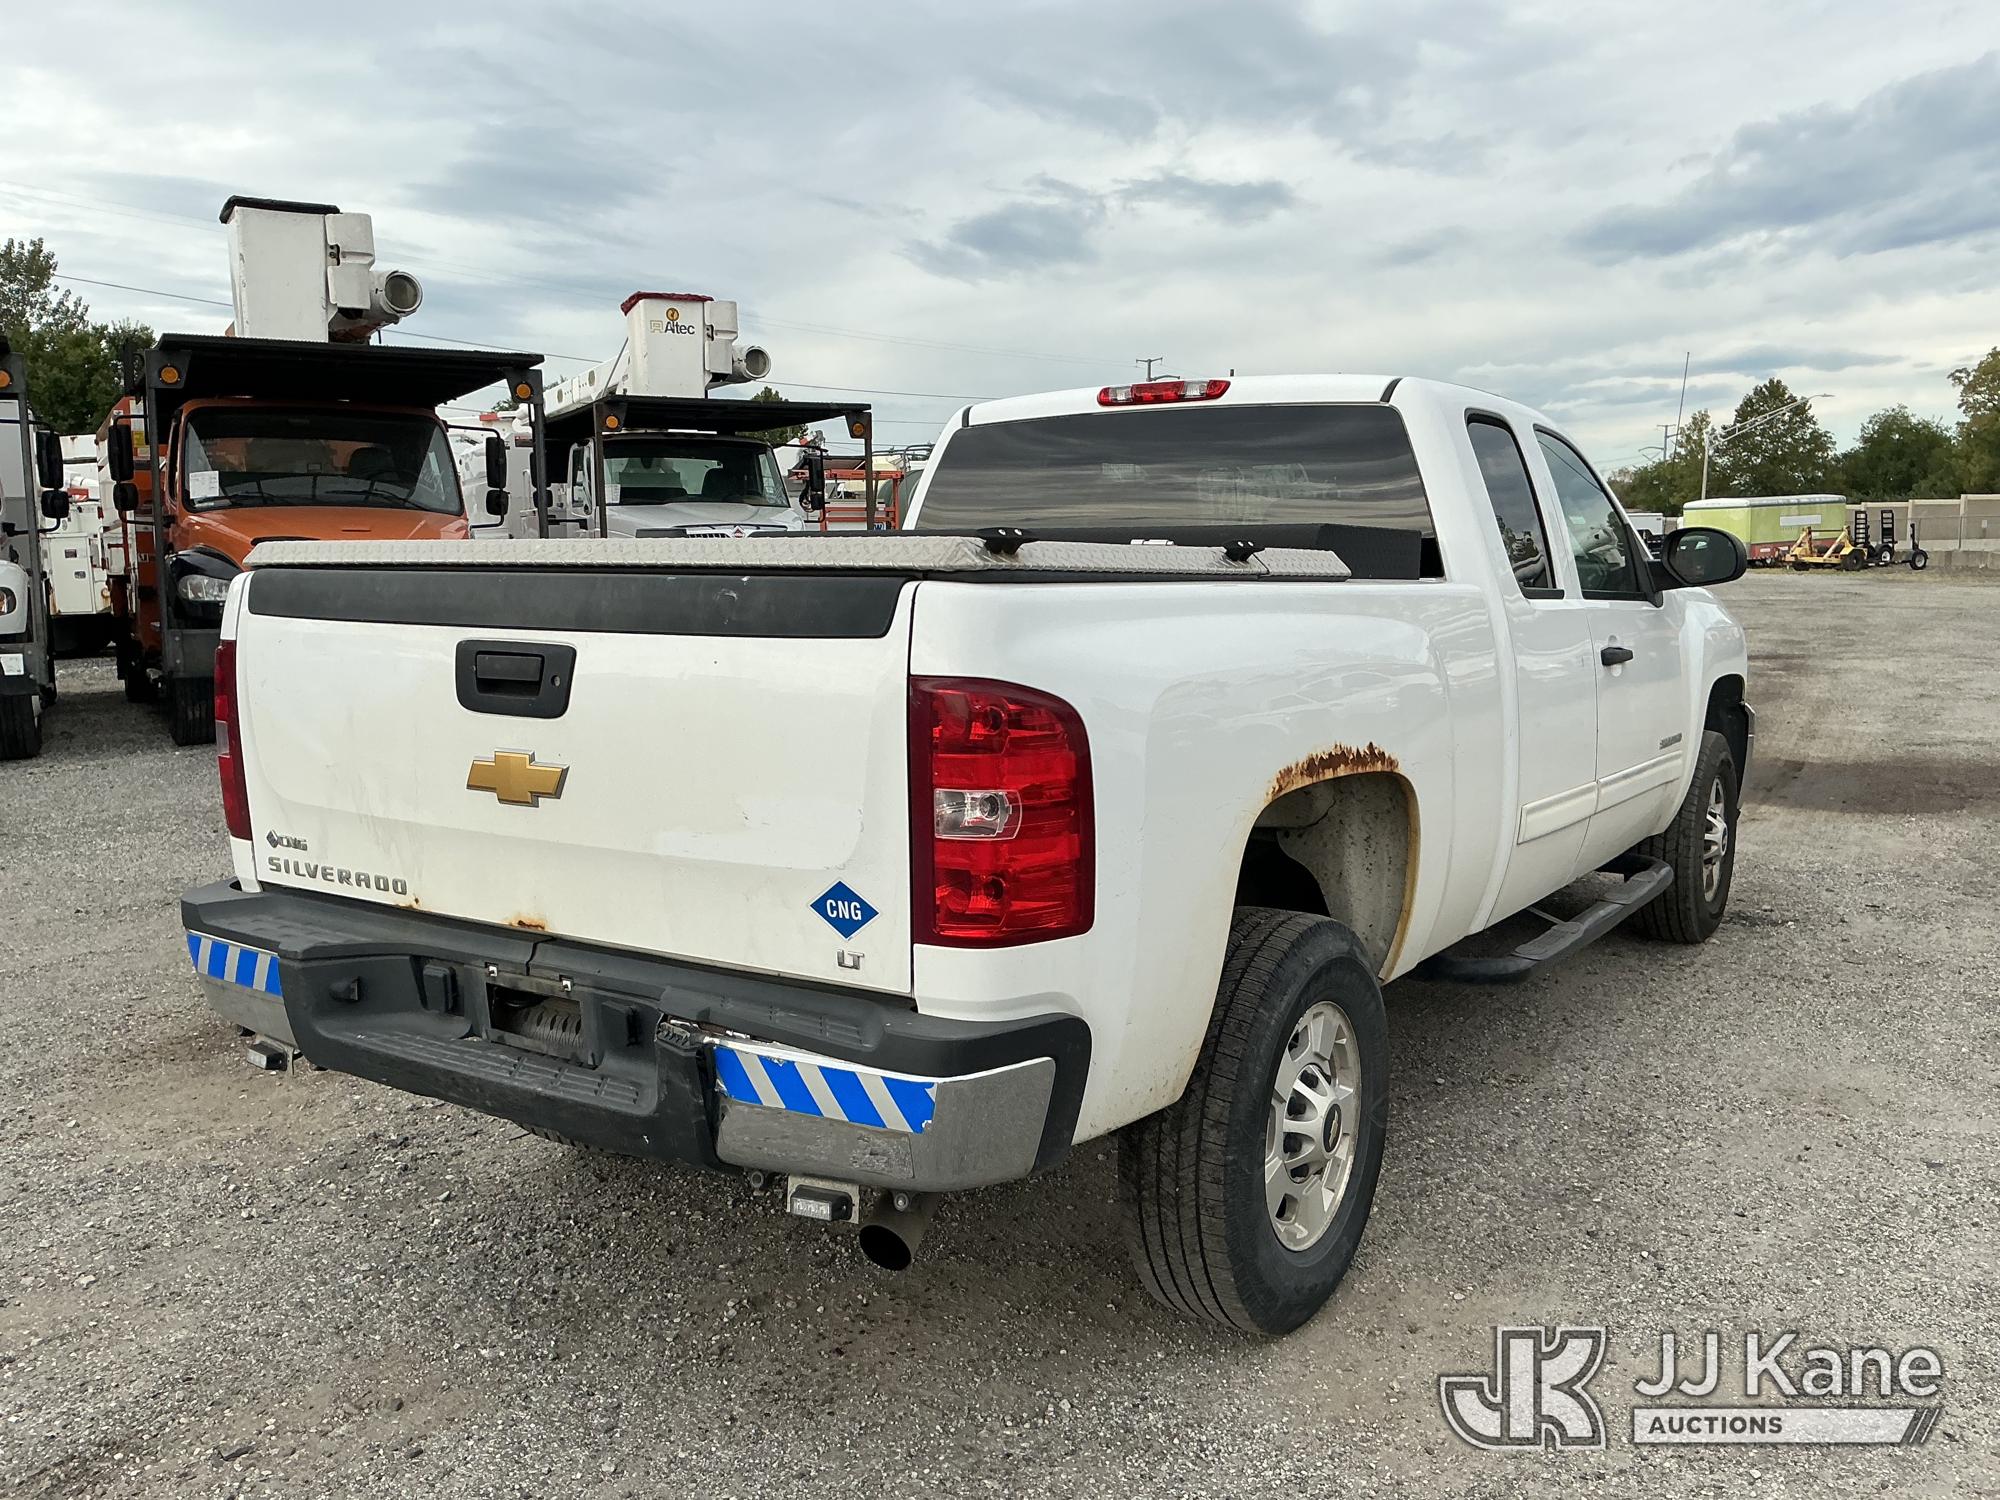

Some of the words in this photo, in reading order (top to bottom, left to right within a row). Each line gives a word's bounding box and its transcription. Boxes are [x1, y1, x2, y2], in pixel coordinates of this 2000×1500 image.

[664, 320, 696, 335] Altec
[268, 856, 408, 896] SILVERADO
[826, 899, 862, 921] CNG
[837, 949, 865, 970] LT
